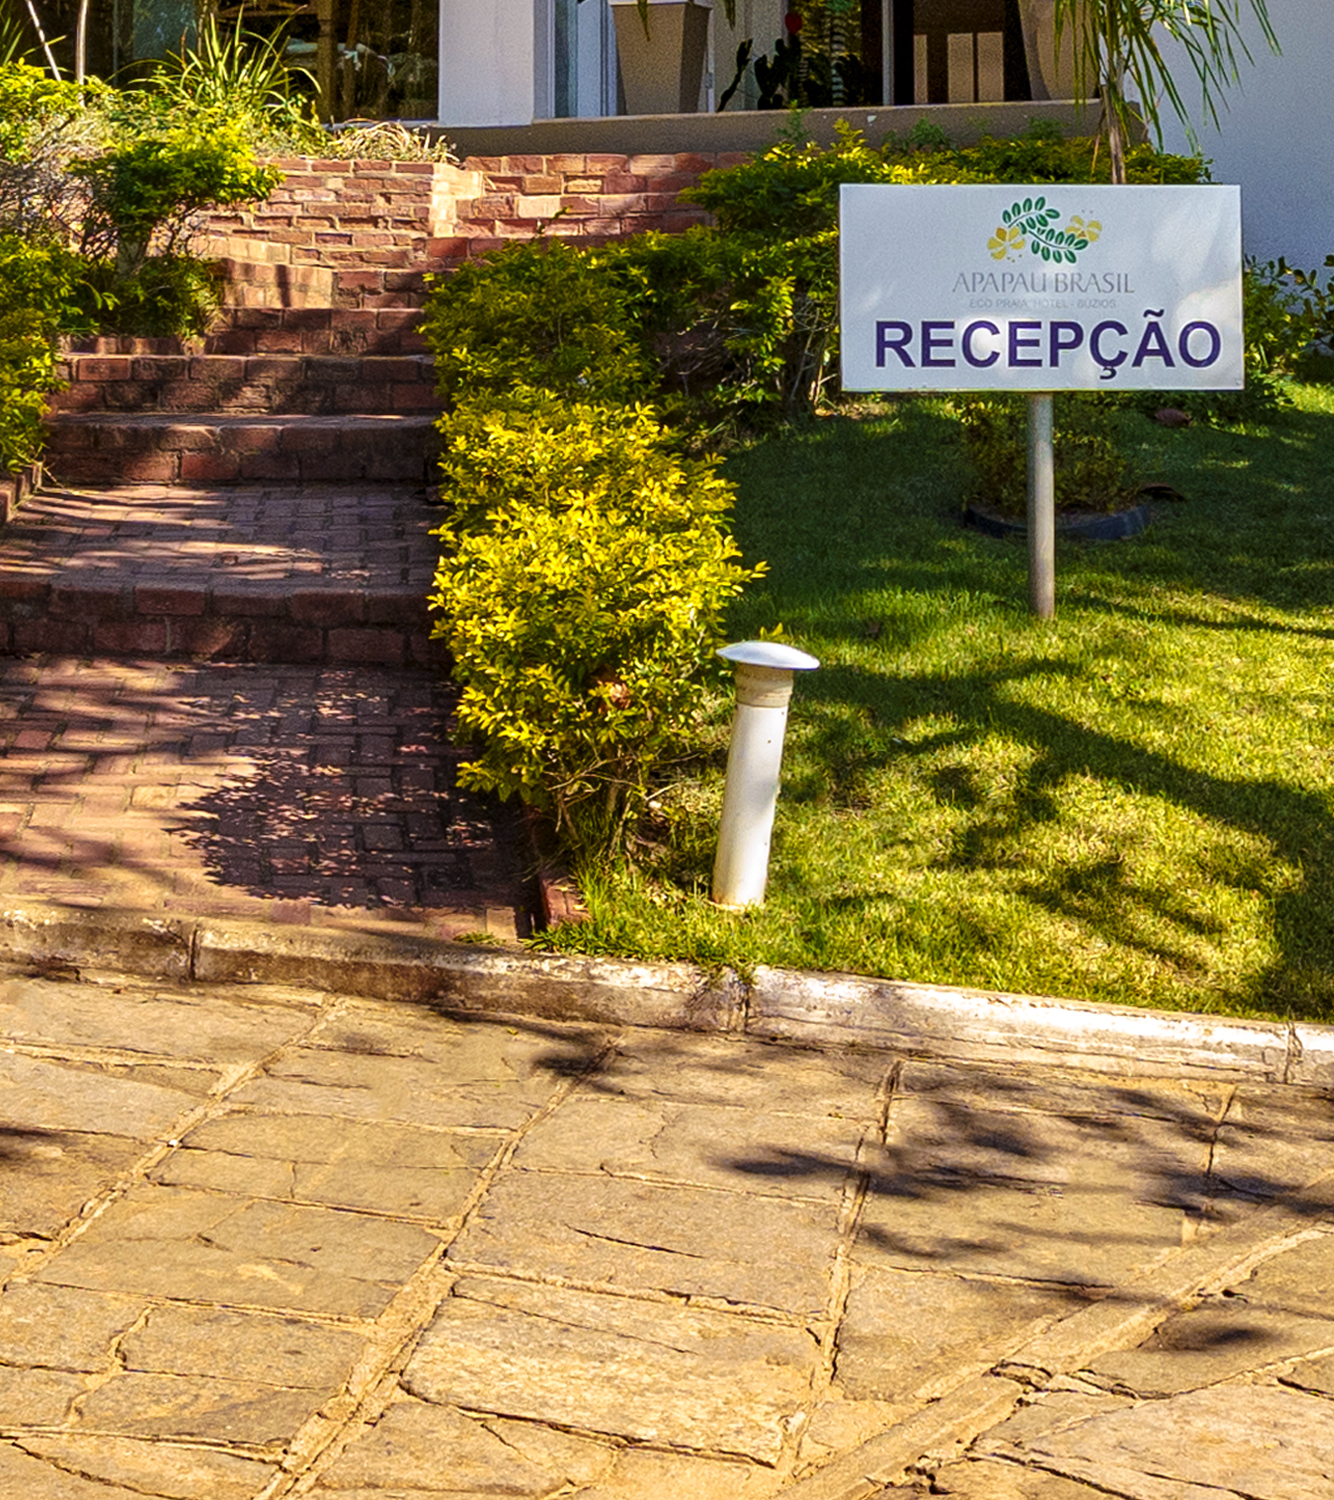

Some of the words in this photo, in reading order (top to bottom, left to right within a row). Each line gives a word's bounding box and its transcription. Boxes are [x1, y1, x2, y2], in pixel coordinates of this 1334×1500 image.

[952, 272, 1047, 293] APAPAU
[1054, 272, 1135, 293] BRASIL
[969, 299, 993, 308] ECO
[874, 308, 1222, 380] RECEPÇÃO
